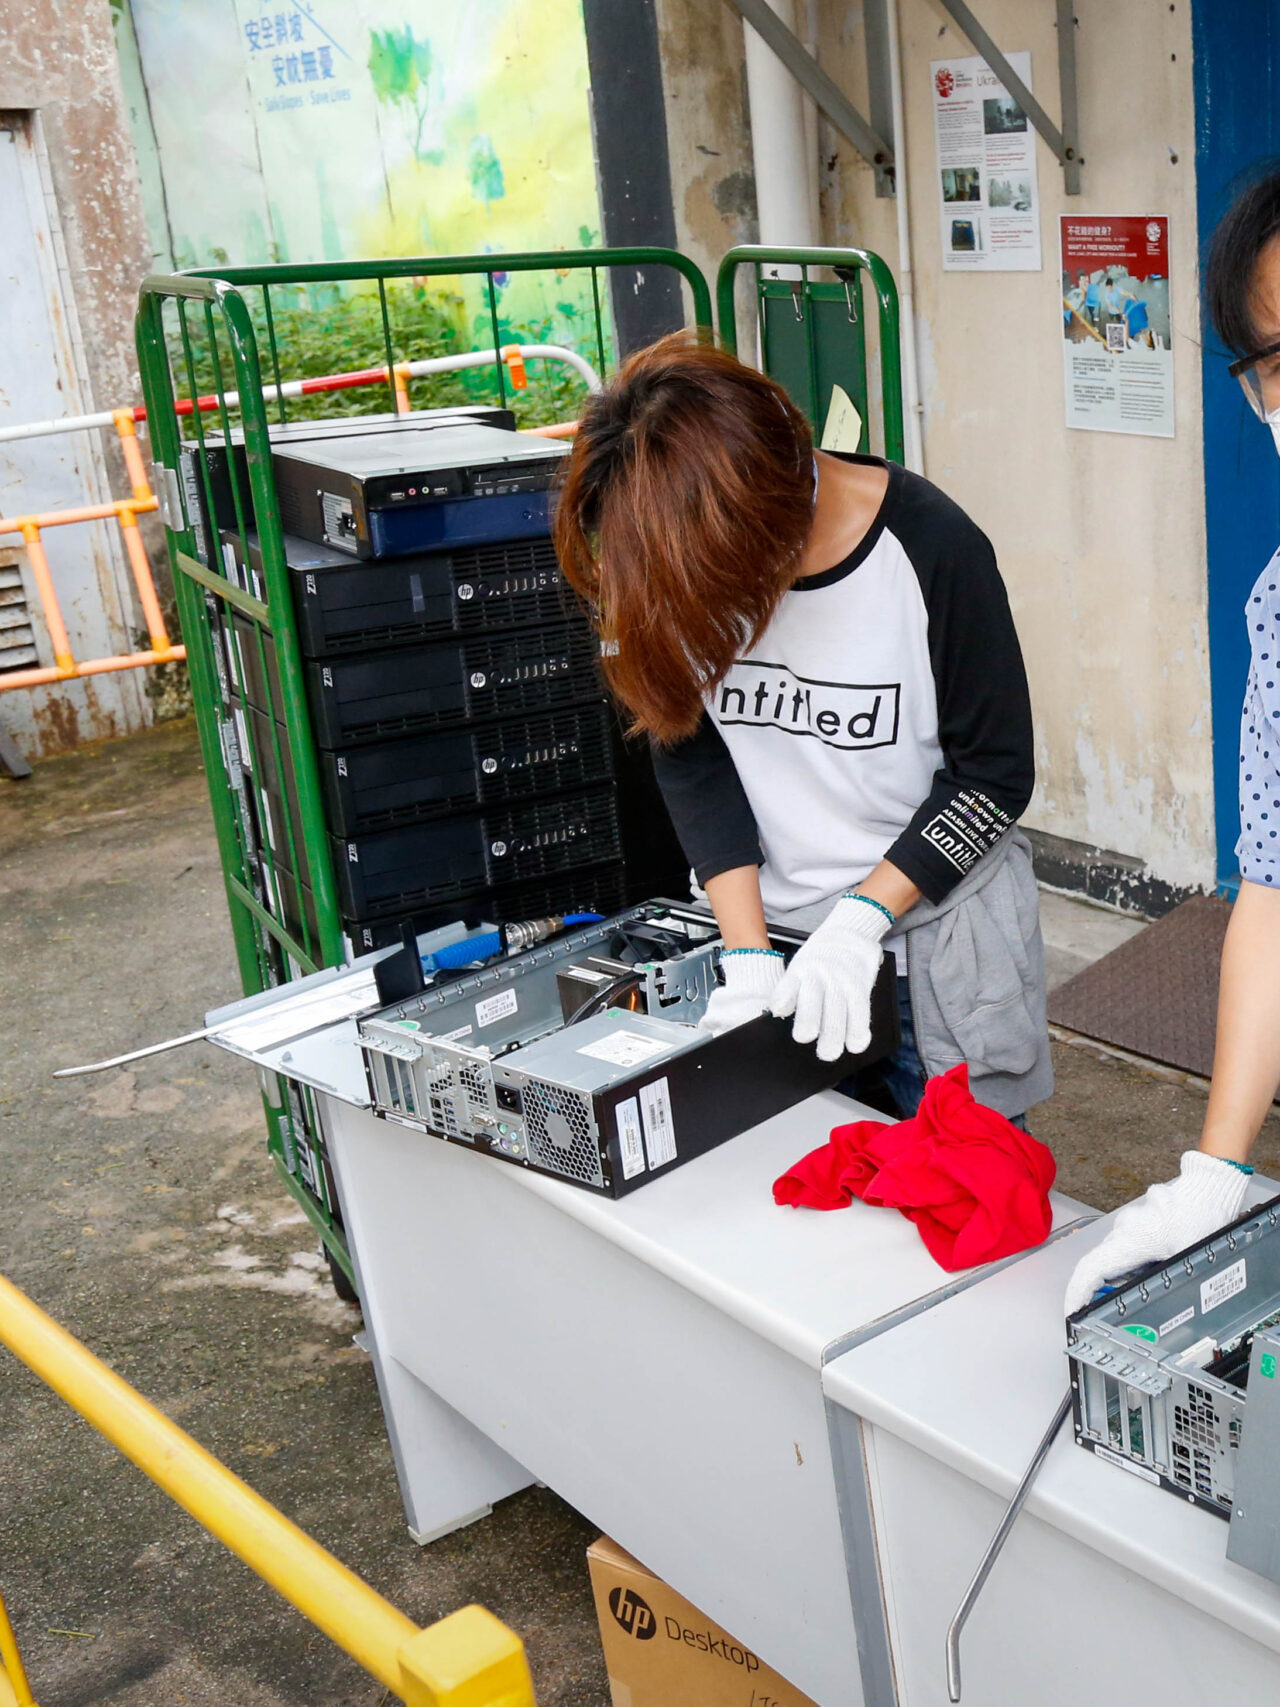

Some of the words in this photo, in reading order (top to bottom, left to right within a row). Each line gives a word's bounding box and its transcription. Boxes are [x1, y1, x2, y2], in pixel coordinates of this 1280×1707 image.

[458, 584, 474, 600] hp
[470, 672, 486, 688] hp
[720, 681, 882, 739] ntitled
[482, 757, 498, 774] hp
[950, 800, 988, 832] unlimited
[958, 791, 994, 824] unknown
[942, 809, 967, 830] ARASHI
[965, 828, 979, 840] LIVE
[491, 841, 507, 856] hp
[1180, 1310, 1193, 1321] CHINA
[609, 1586, 656, 1640] hp
[665, 1616, 760, 1673] Desktop
